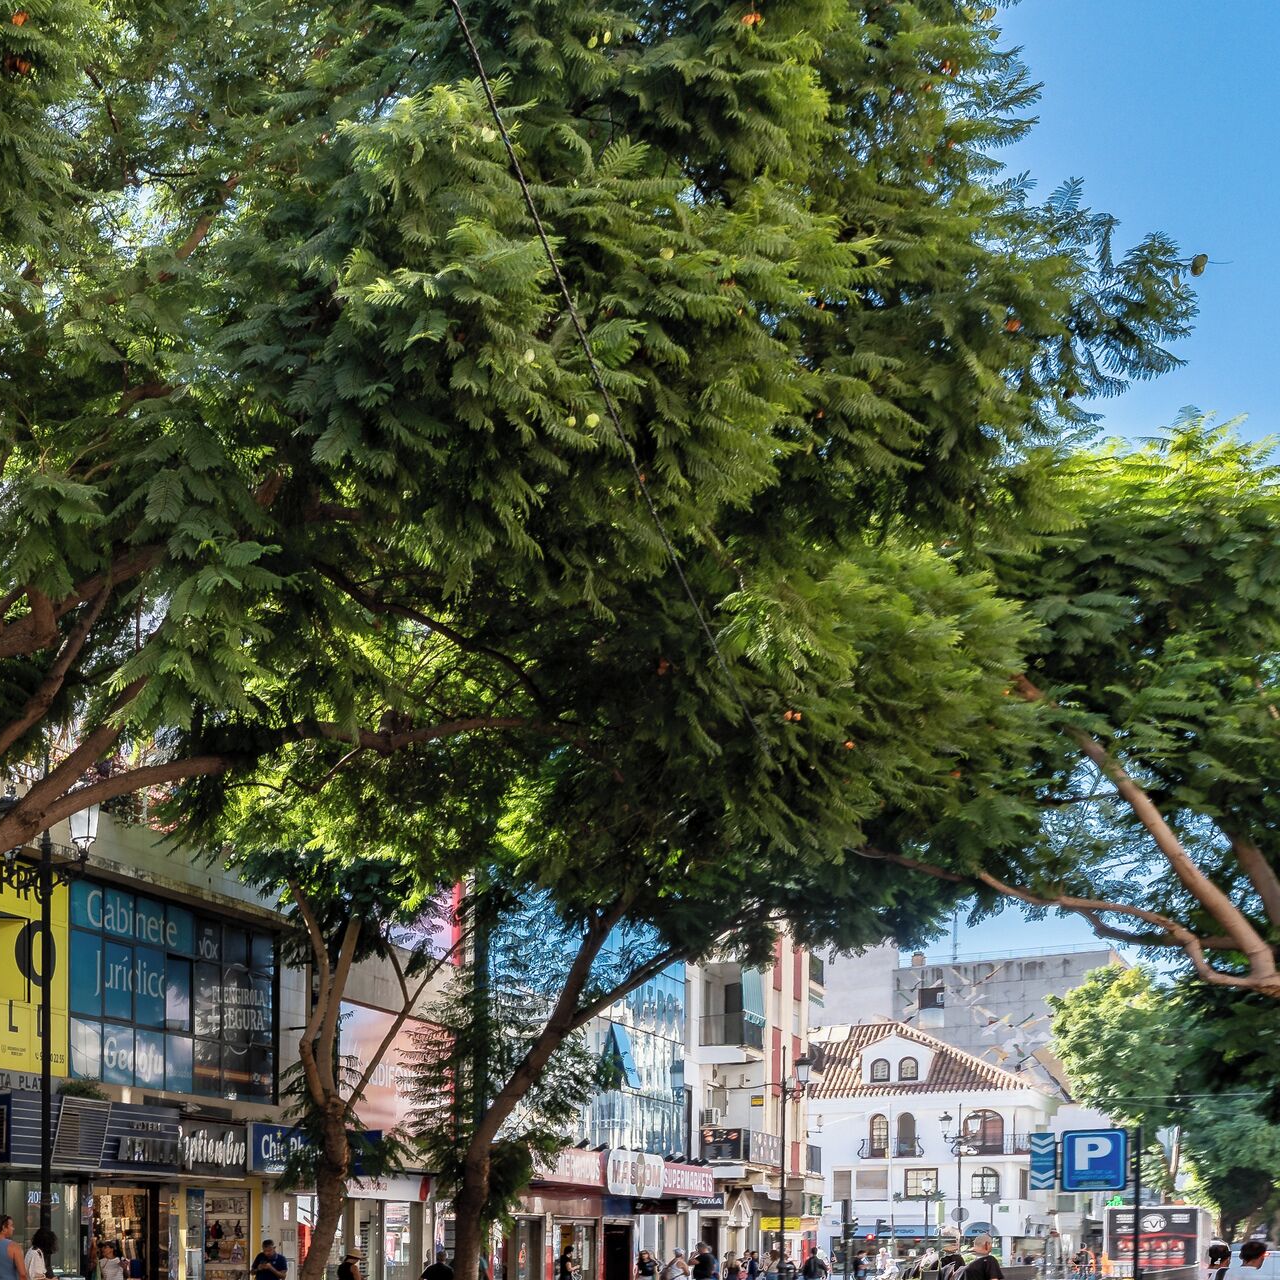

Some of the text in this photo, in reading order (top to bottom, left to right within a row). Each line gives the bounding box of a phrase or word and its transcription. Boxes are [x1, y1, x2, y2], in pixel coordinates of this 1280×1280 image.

[87, 890, 177, 947] Gabinete
[199, 938, 218, 959] VOX
[261, 1134, 287, 1161] Chic
[1074, 1136, 1113, 1170] P
[663, 1167, 713, 1193] SUPERMARKETS
